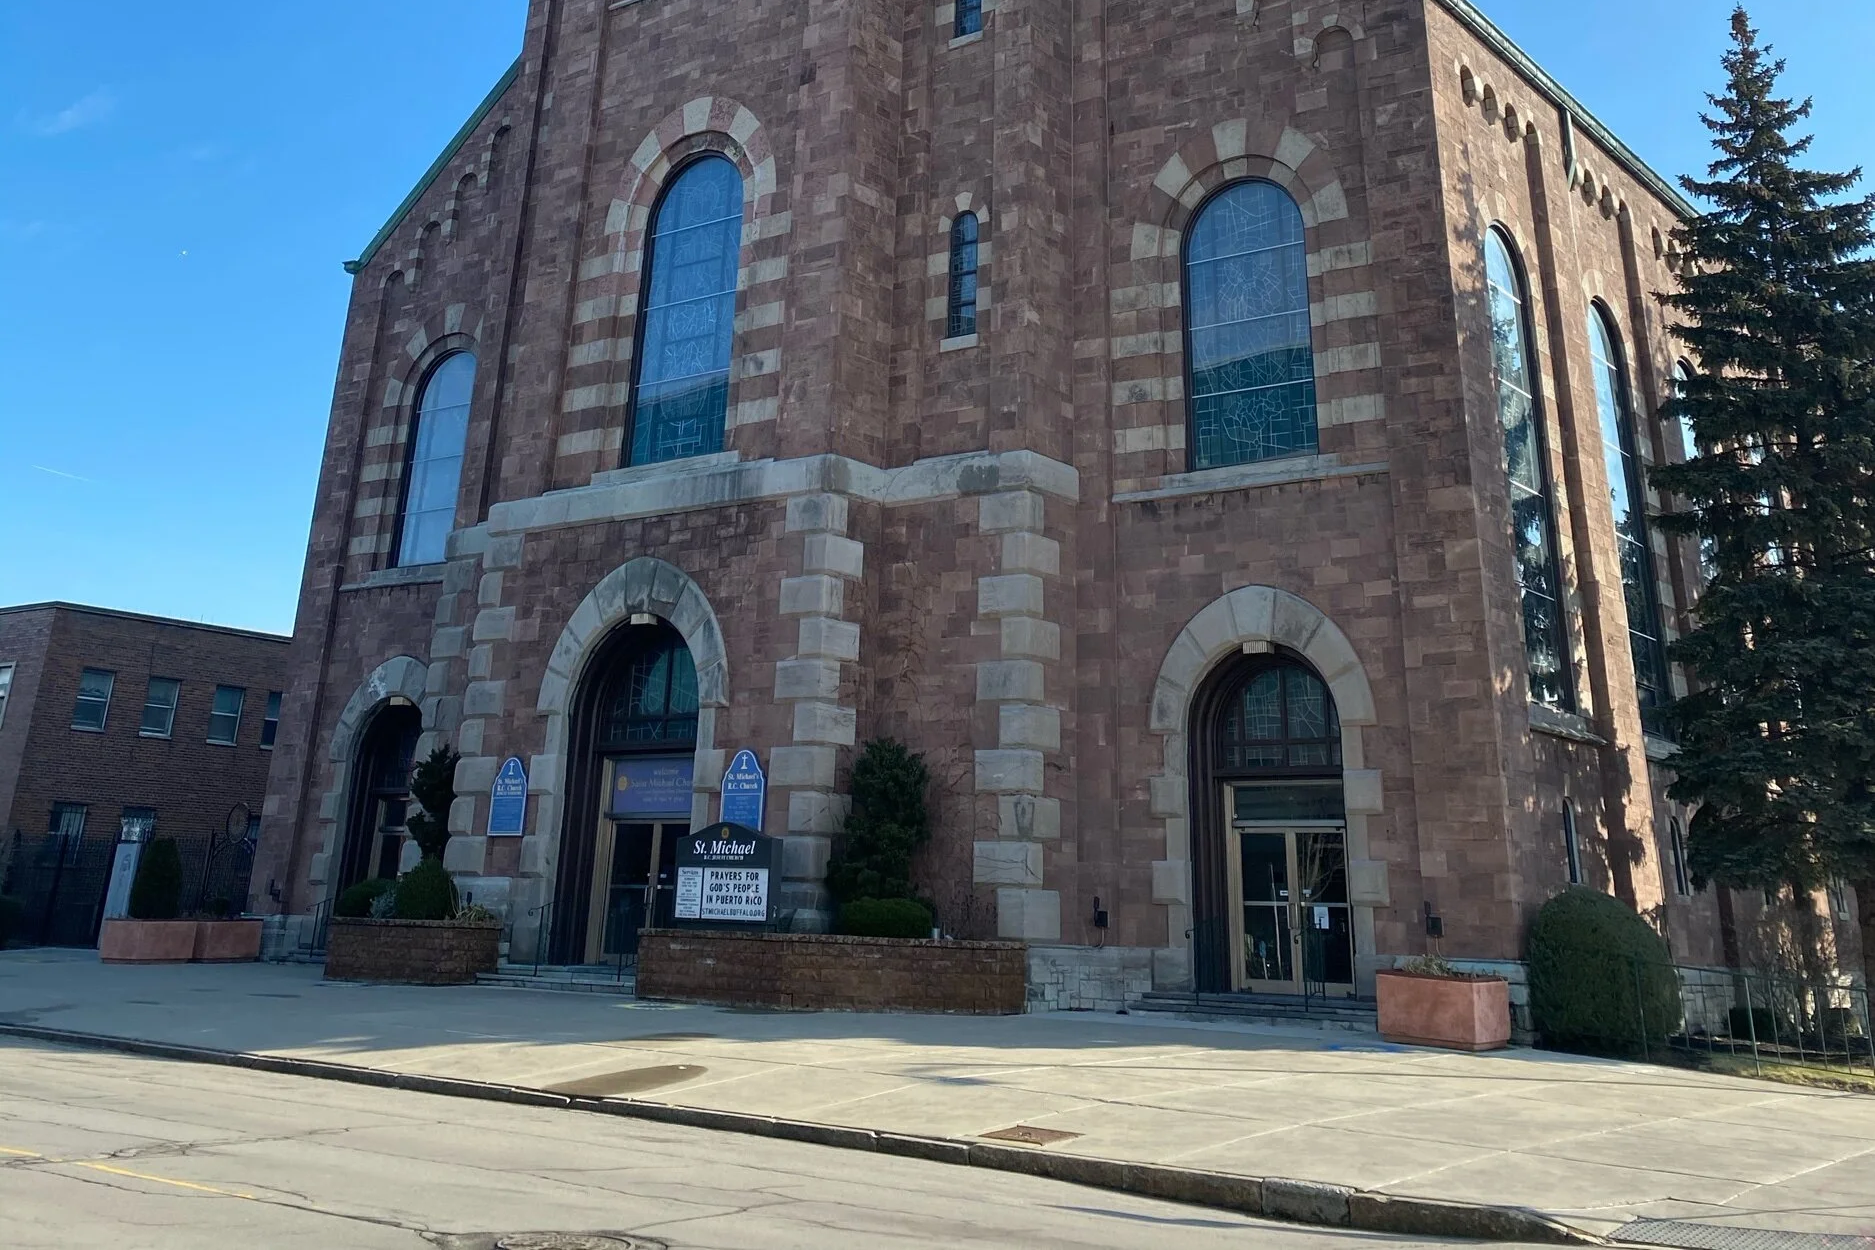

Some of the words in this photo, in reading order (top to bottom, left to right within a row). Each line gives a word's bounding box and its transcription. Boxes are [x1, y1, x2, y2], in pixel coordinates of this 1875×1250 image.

[693, 840, 707, 855] St.
[710, 840, 756, 855] Michael
[710, 871, 742, 881] PRAYERS
[746, 872, 759, 881] FOR
[710, 883, 730, 893] GOD'S
[733, 884, 760, 893] PEOPLE
[706, 895, 713, 904] IN
[716, 895, 743, 905] PUERTO
[745, 896, 762, 905] RICO
